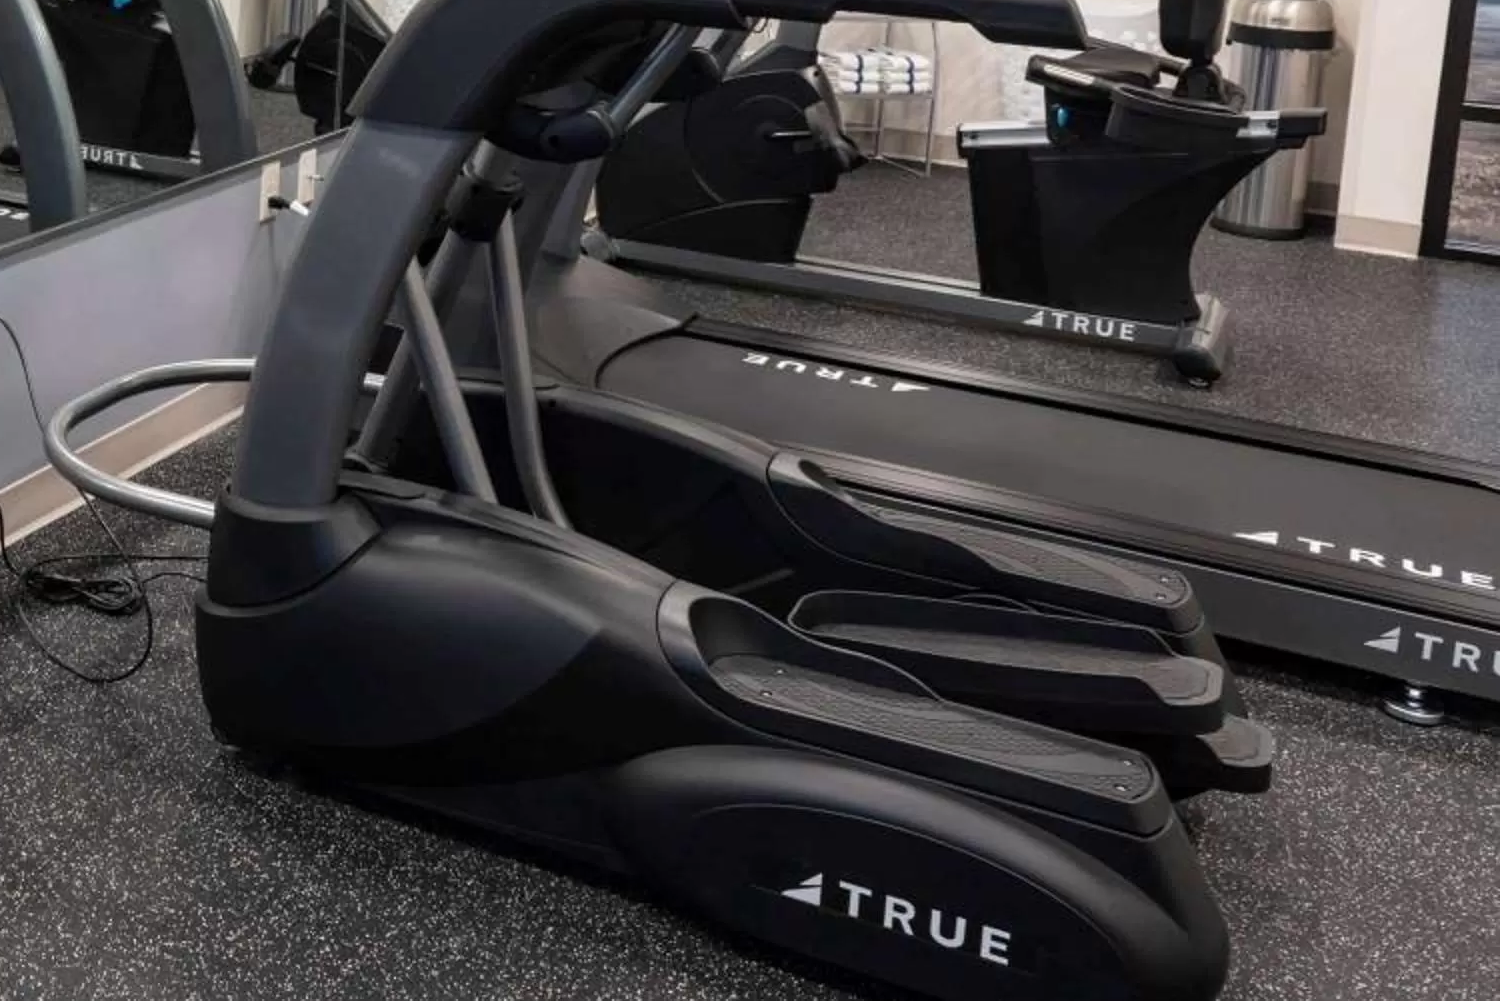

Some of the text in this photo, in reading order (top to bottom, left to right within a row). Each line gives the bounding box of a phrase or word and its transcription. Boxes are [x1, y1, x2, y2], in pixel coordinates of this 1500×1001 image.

[1052, 312, 1135, 341] TRUE
[741, 352, 879, 388] TRUE
[1297, 536, 1496, 590] TRUE
[1414, 631, 1500, 676] TR
[839, 880, 1011, 966] TRUE
